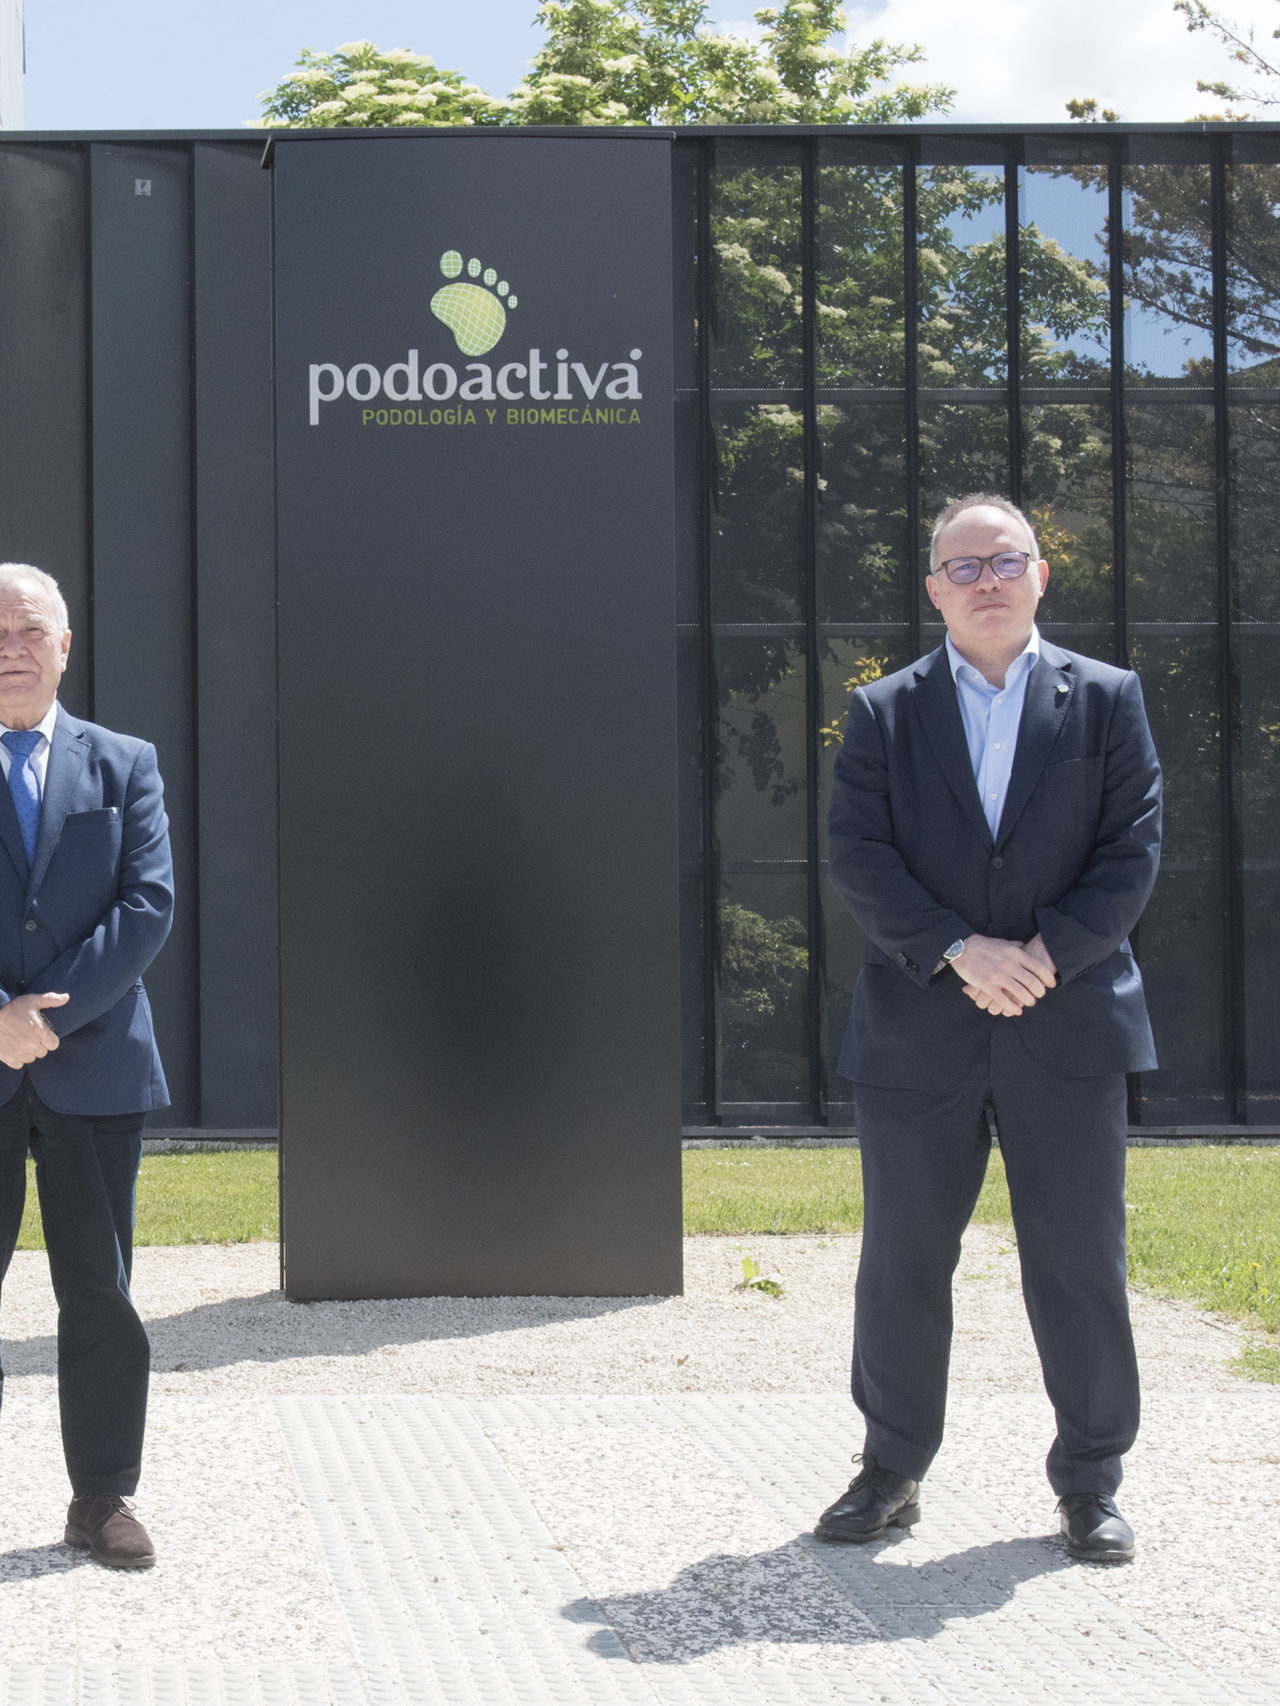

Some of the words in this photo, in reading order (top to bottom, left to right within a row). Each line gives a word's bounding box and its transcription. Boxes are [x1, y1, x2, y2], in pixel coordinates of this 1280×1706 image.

[309, 348, 643, 426] podoactiva
[362, 404, 477, 426] PODOLOGÍA
[486, 408, 497, 425] Y
[506, 403, 642, 425] BIOMECÁNICA
